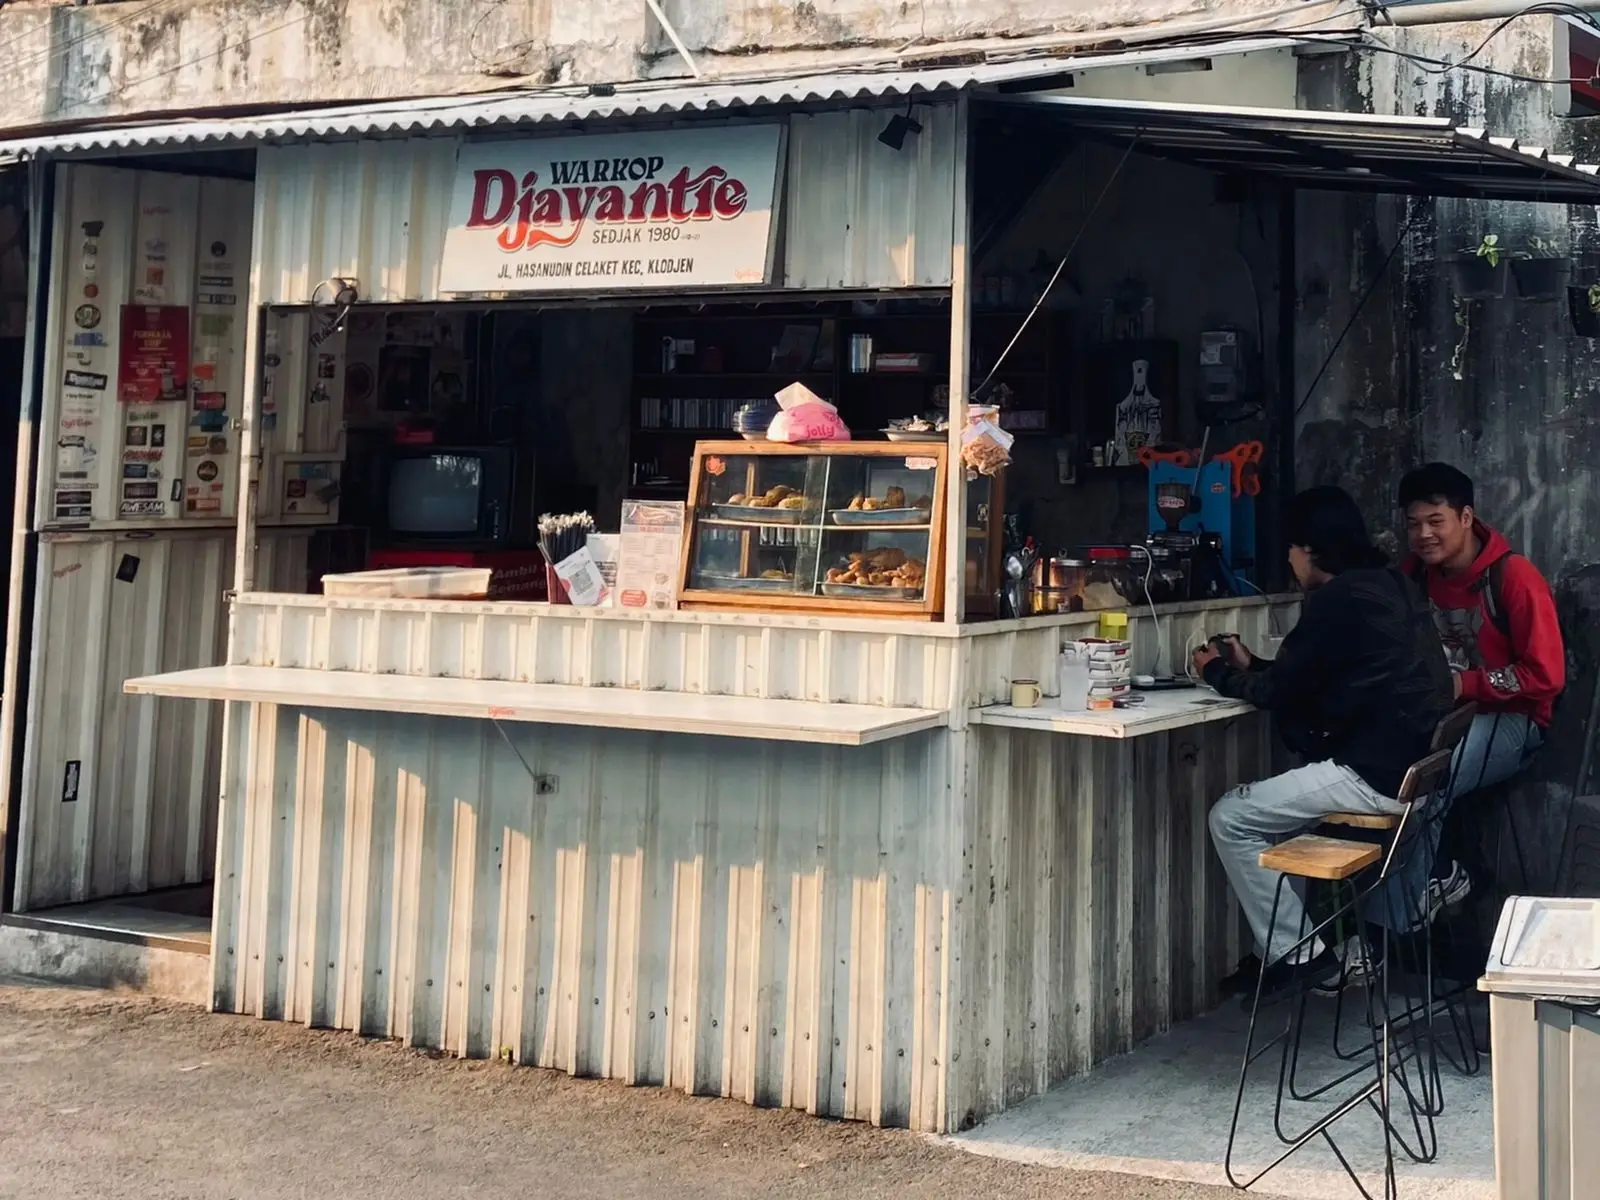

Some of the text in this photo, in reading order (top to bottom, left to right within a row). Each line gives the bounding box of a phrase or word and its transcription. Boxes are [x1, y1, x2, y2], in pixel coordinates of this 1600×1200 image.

[551, 155, 664, 185] WARKOP
[466, 164, 748, 252] Djayantie
[592, 228, 641, 245] SEDJAK
[648, 226, 680, 242] 1980
[515, 261, 573, 278] HASANUDIN
[575, 259, 618, 277] CELAKET
[648, 257, 694, 275] KLODJEN
[805, 424, 835, 439] jolly
